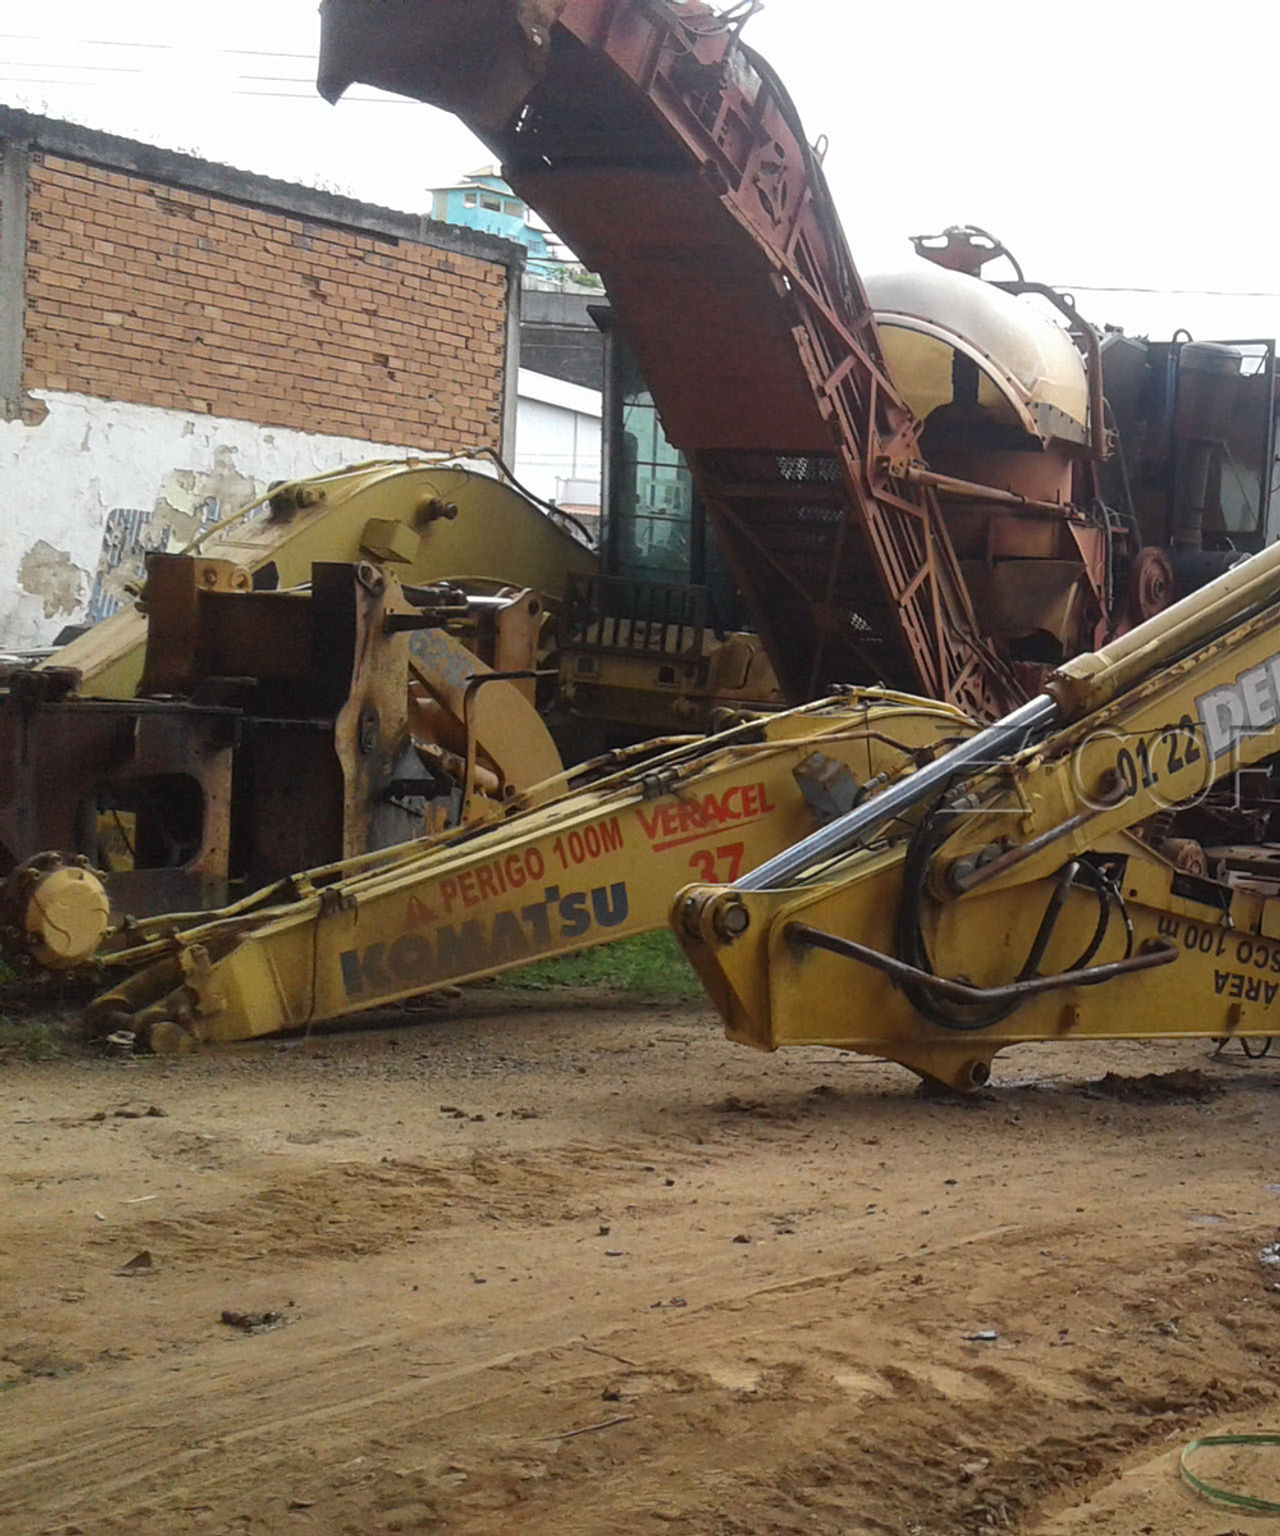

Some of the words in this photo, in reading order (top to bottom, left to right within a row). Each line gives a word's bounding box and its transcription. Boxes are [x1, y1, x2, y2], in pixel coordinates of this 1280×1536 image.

[1117, 738, 1158, 797] 01
[1162, 714, 1201, 775] 22
[635, 782, 775, 841] VERACEL
[439, 847, 545, 913] PERIGO
[552, 818, 624, 871] 100M
[339, 881, 629, 998] KOMATSU
[1157, 915, 1180, 938] m
[1183, 924, 1227, 957] 100
[1213, 968, 1280, 1010] ÁREA
